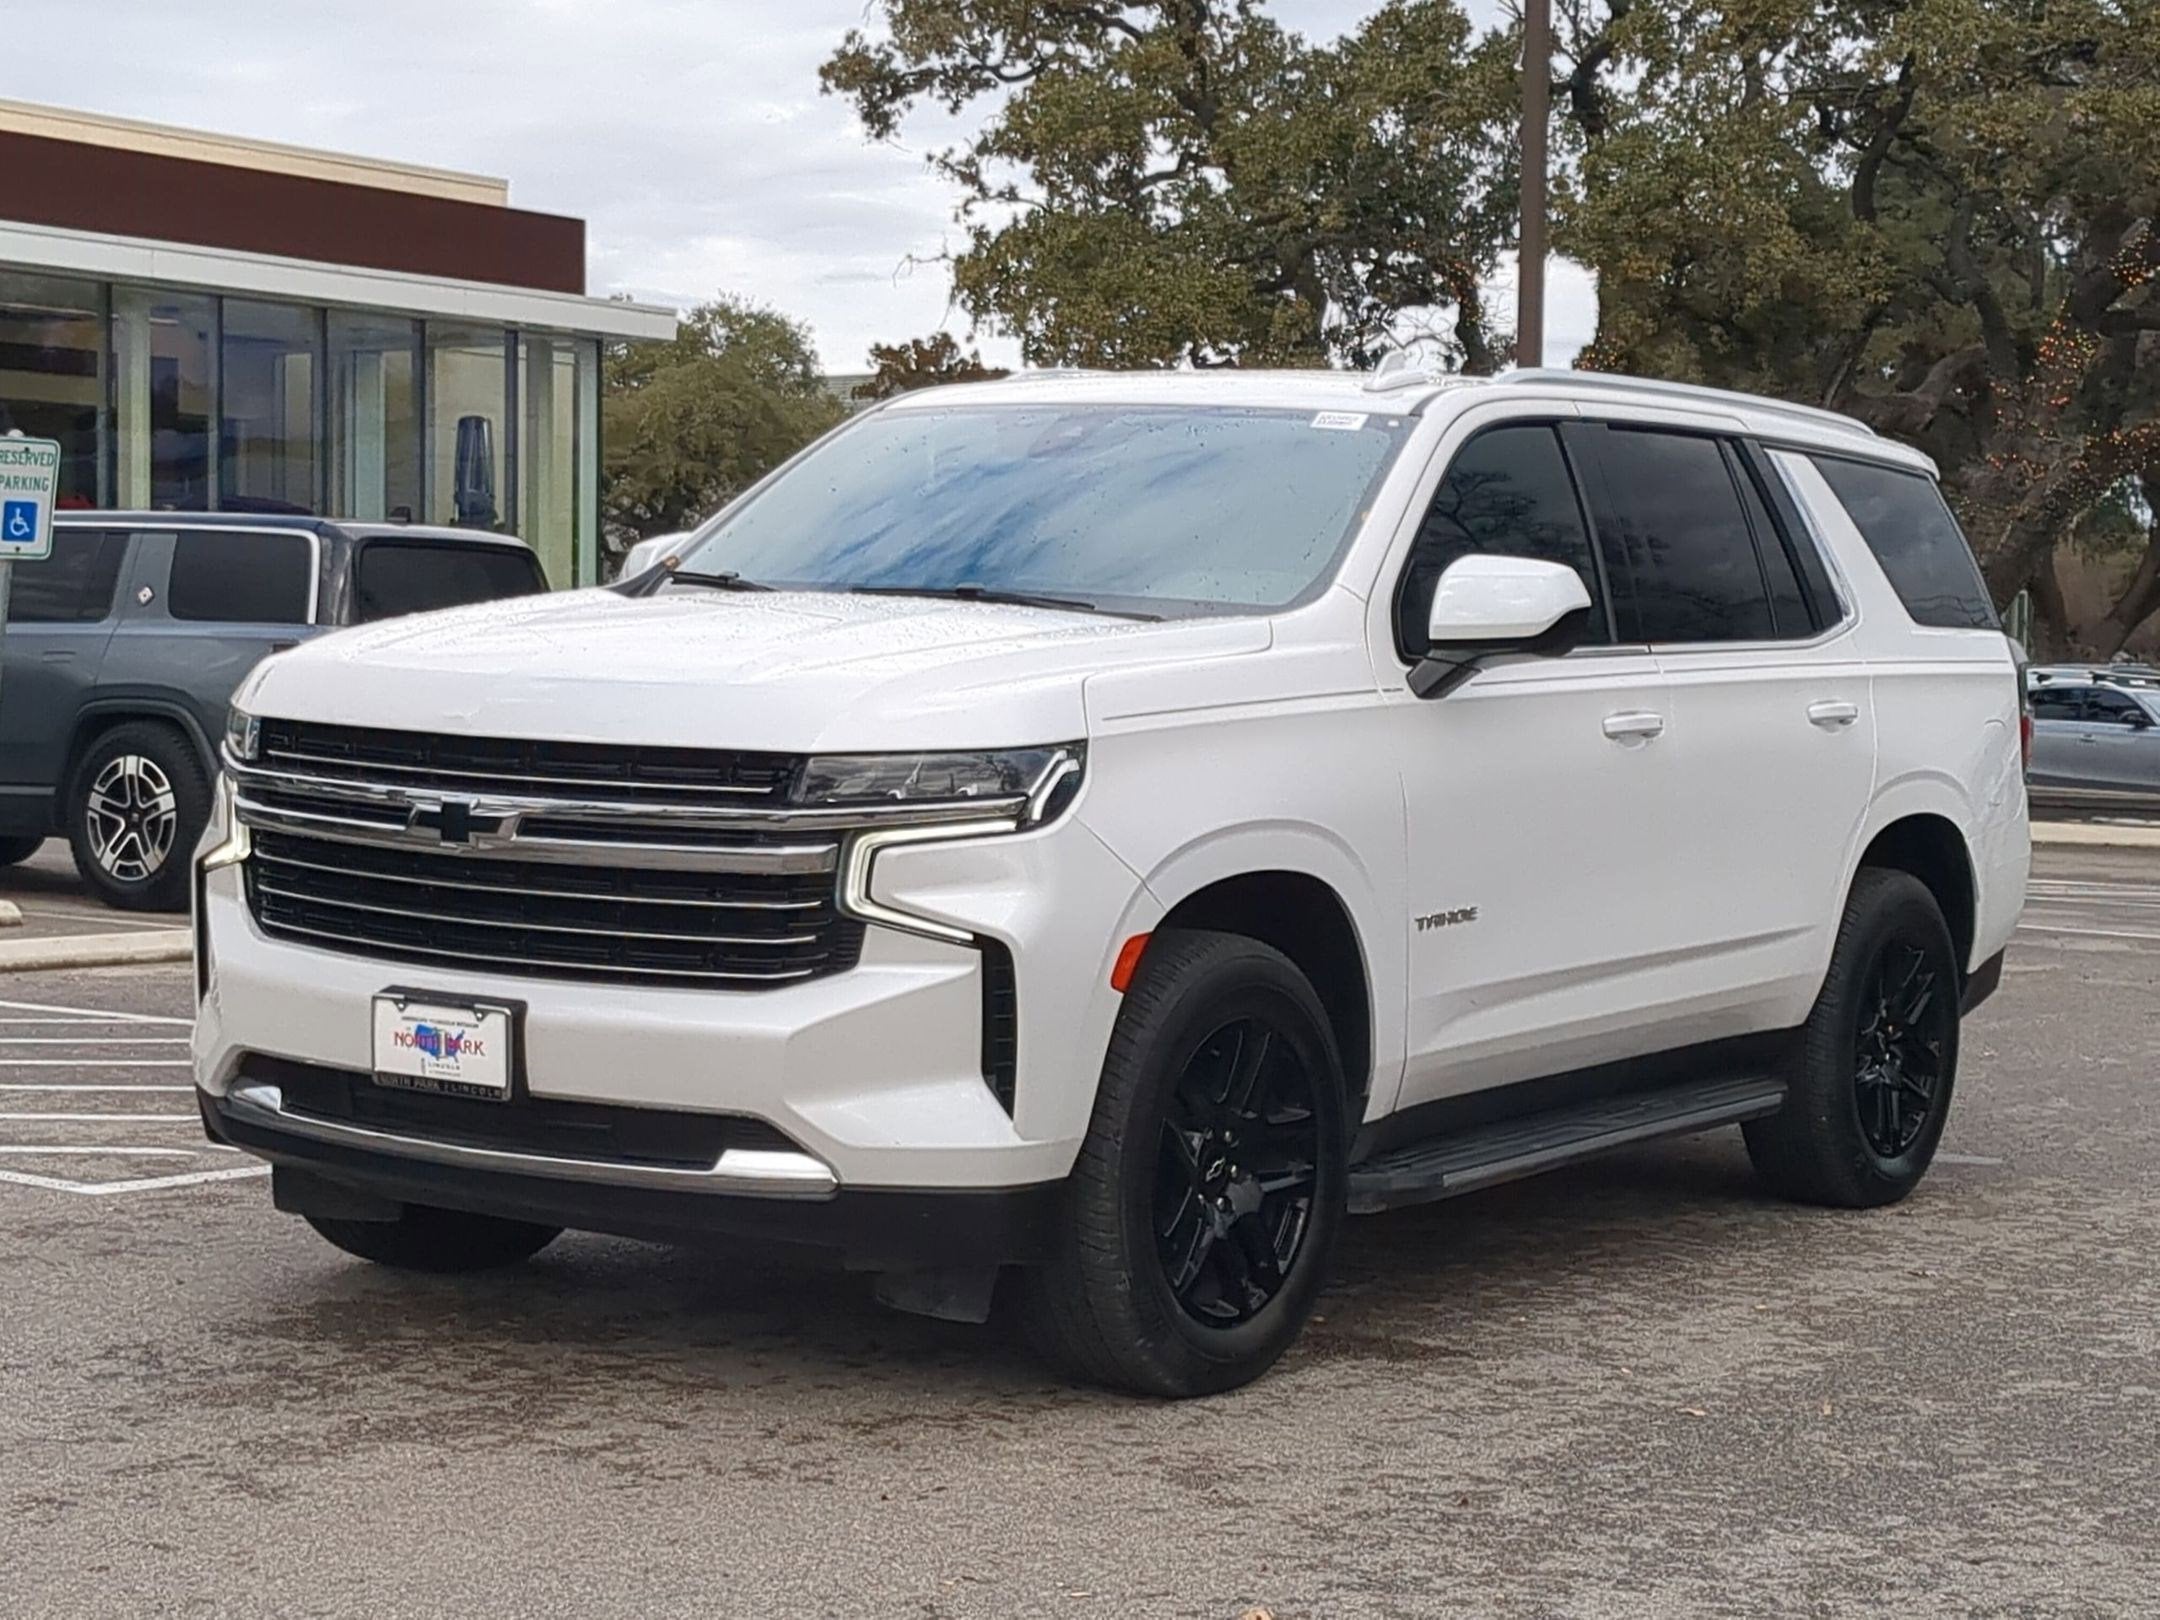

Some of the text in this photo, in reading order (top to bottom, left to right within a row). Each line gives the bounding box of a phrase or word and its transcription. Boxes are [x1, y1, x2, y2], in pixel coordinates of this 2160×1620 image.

[0, 450, 54, 466] RESERVED
[0, 474, 49, 492] PARKING
[1414, 906, 1478, 931] TAHOE
[445, 1032, 485, 1056] PARK
